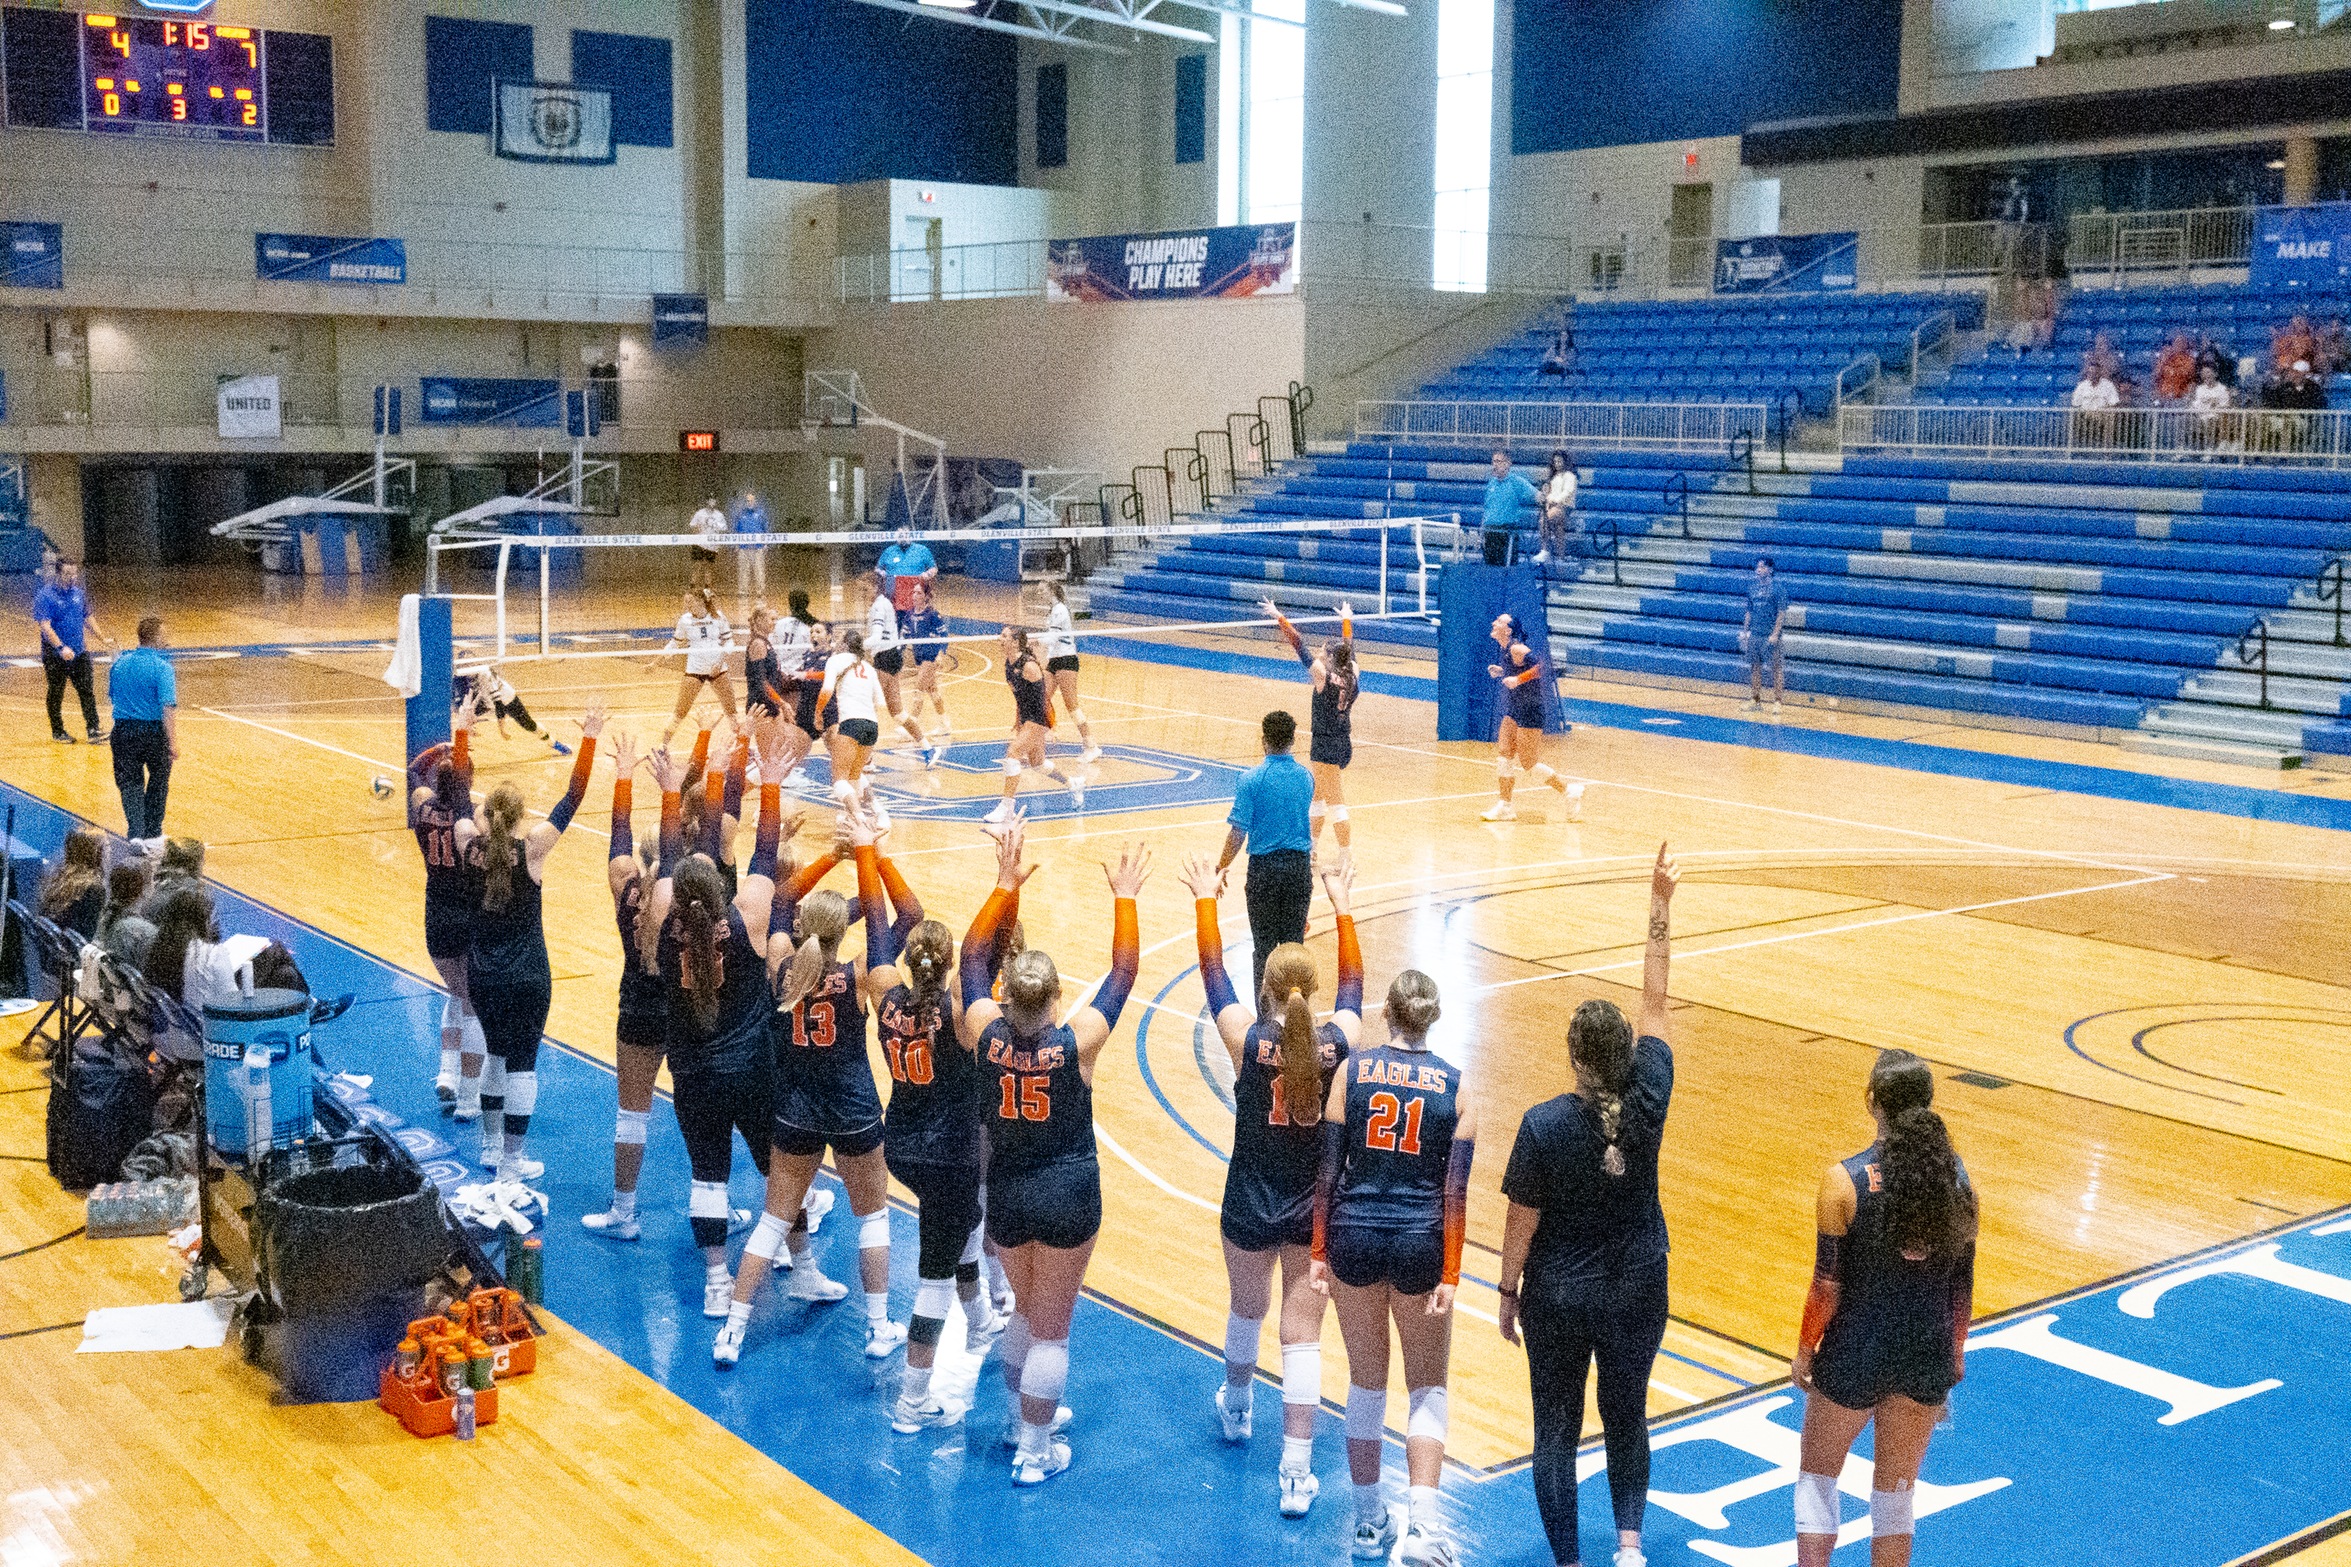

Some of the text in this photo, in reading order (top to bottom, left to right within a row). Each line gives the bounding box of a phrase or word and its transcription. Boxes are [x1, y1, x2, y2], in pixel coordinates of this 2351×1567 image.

[110, 32, 130, 58] 4
[163, 22, 210, 50] 1:15
[240, 41, 257, 69] 7
[103, 93, 120, 116] 0
[172, 99, 187, 121] 3
[242, 103, 258, 125] 2
[1124, 236, 1209, 265] CHAMPIONS
[330, 263, 401, 279] BASKETBALL
[1128, 262, 1202, 290] PLAY HERE
[226, 397, 271, 411] UNITED
[687, 433, 713, 450] EXIT
[555, 536, 609, 545] GLENVILLE
[612, 536, 642, 544] STATE
[707, 534, 757, 542] GLENVILLE
[761, 534, 789, 542] STATE
[848, 532, 895, 540] GLENVILLE
[898, 531, 925, 539] STATE
[783, 631, 795, 645] 11
[428, 829, 455, 867] 11
[792, 1001, 837, 1047] 13
[886, 1037, 935, 1085] 10
[987, 1038, 1065, 1072] EAGLES
[1357, 1057, 1449, 1094] EAGLES
[999, 1073, 1051, 1122] 15
[1366, 1090, 1426, 1155] 21
